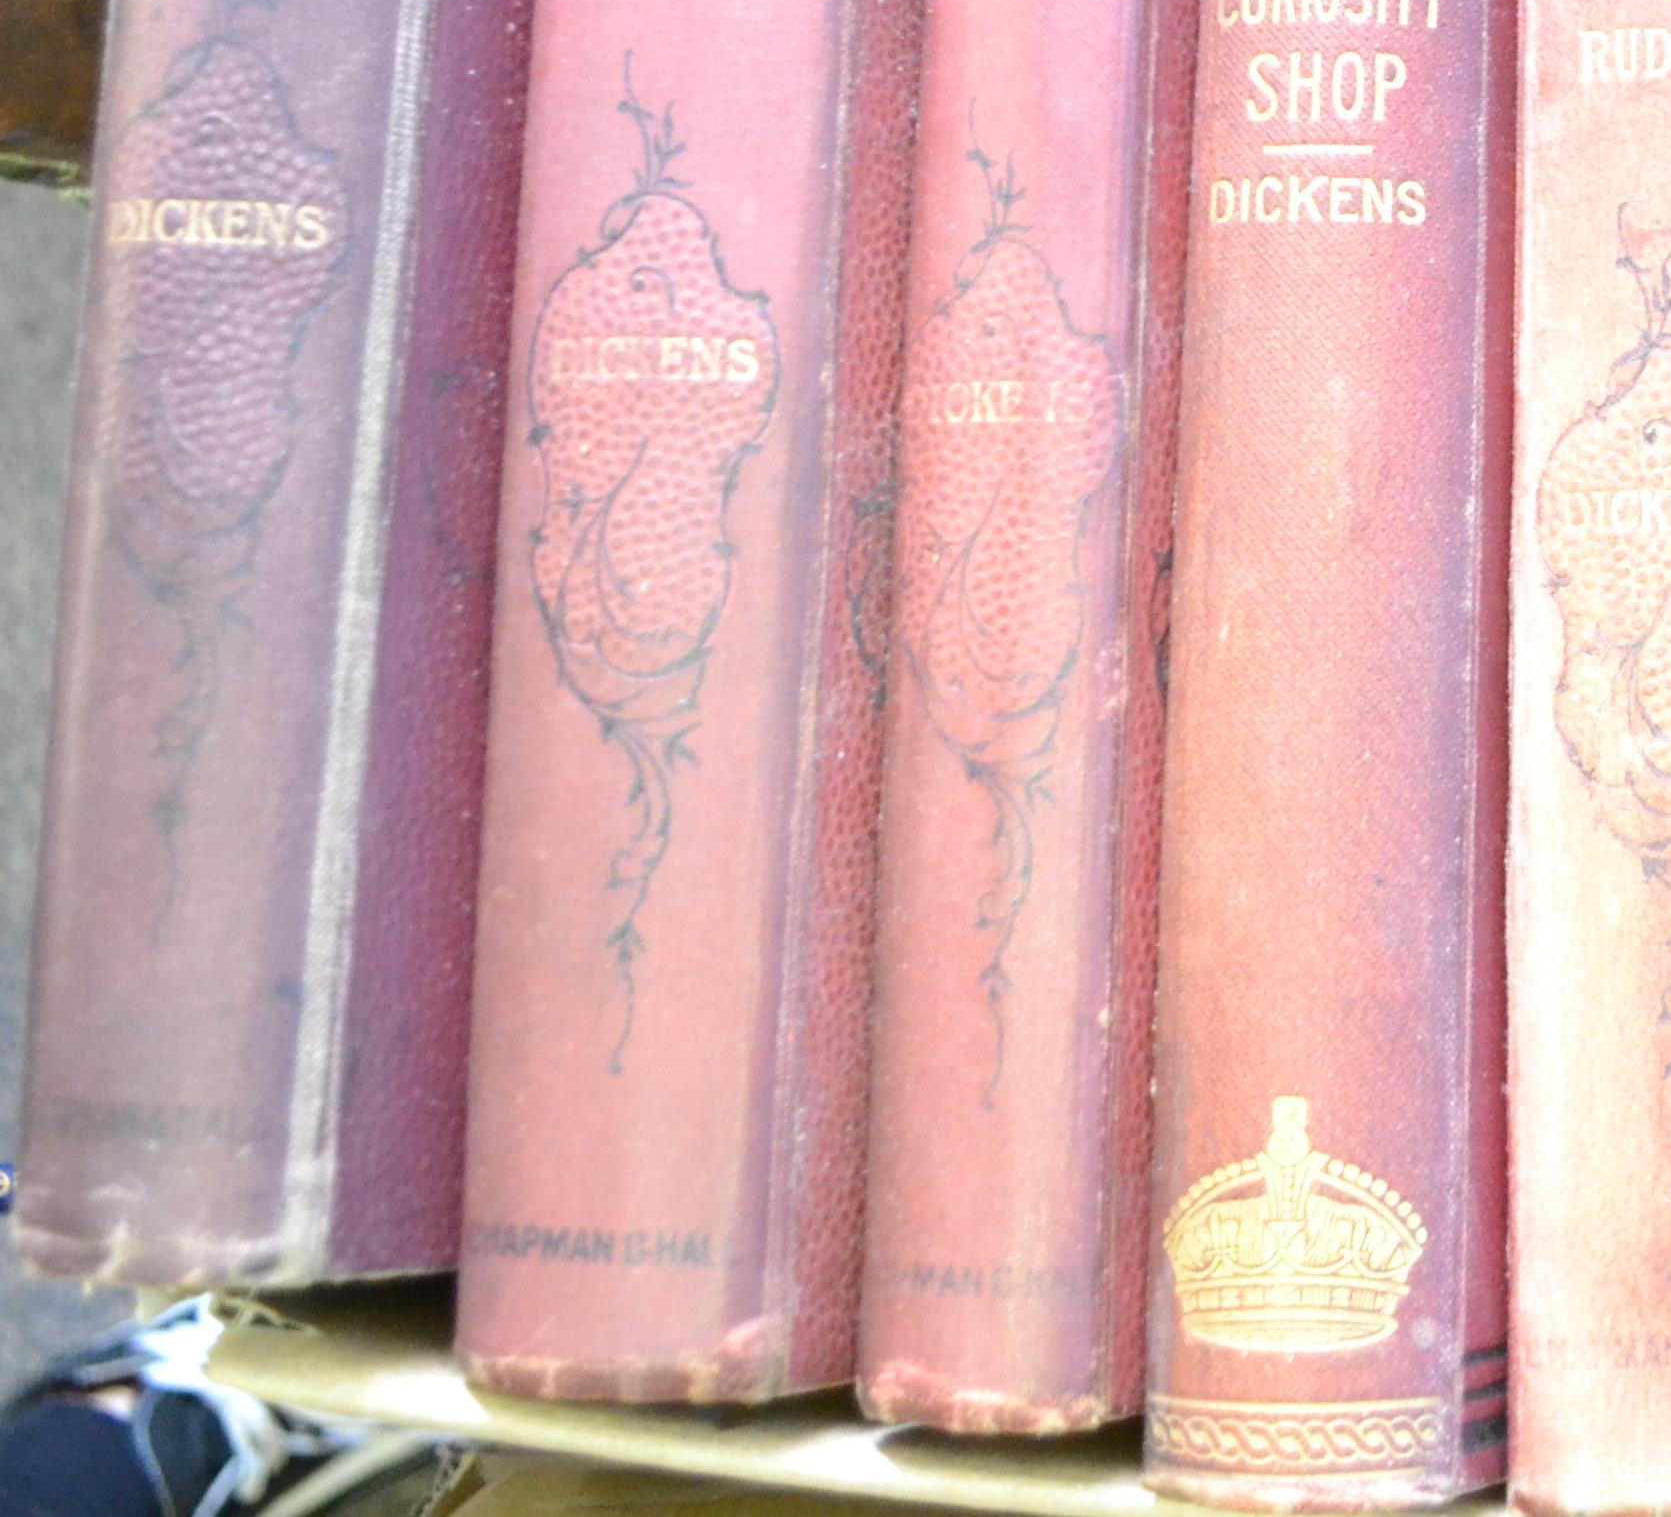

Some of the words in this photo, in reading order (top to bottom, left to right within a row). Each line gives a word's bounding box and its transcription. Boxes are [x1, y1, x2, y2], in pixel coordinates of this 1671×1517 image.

[1247, 52, 1407, 123] SHOP
[105, 198, 329, 250] DICKENS
[1209, 175, 1428, 226] DICKENS
